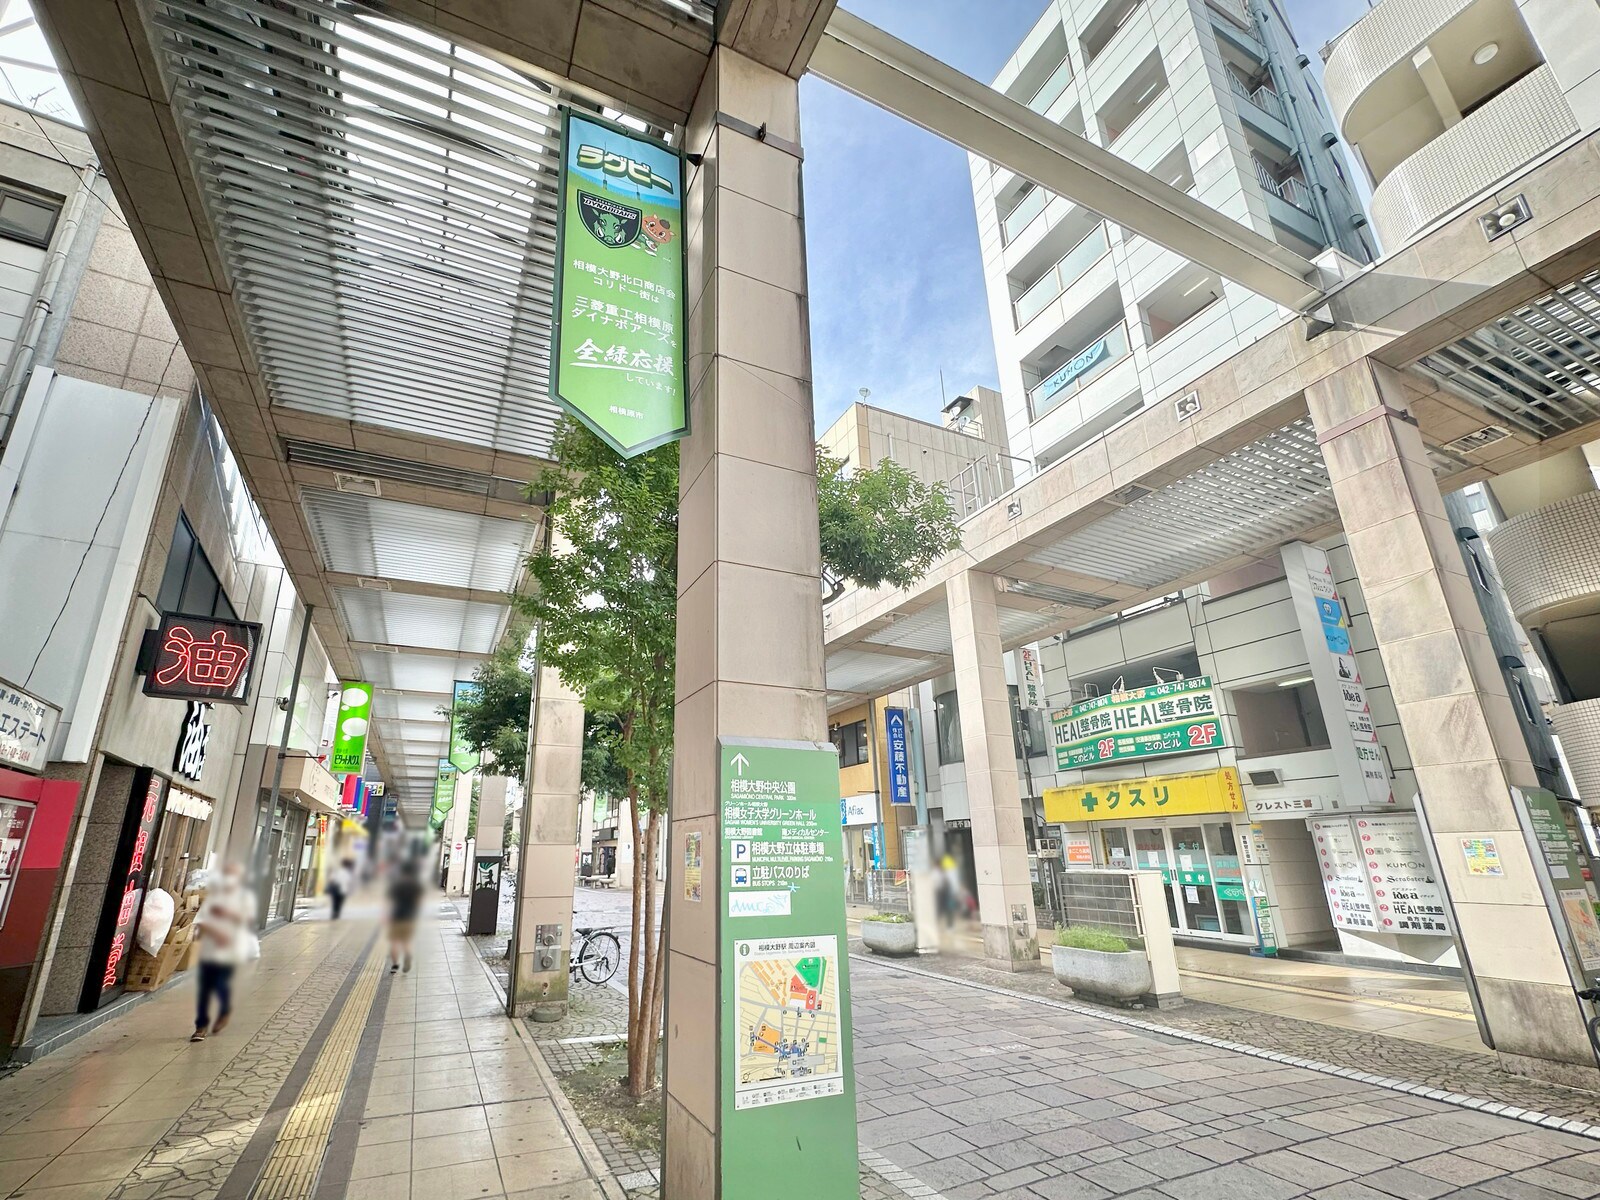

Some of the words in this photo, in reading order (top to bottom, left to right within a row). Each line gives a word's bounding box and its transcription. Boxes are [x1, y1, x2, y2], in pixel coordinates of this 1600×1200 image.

[577, 144, 674, 195] ラグビー
[573, 259, 675, 300] 相模大野北口商店会
[593, 276, 660, 303] コリドー街は
[574, 295, 674, 335] 三菱重工相模原
[573, 338, 675, 377] 全緑応援
[1053, 351, 1094, 387] KUMON
[608, 405, 645, 420] 相模原市
[157, 627, 248, 687] 油
[1156, 679, 1207, 695] 042-747-8874
[1188, 724, 1217, 746] 2F
[1098, 738, 1114, 758] 2F
[1145, 739, 1182, 751] このビル
[1073, 752, 1095, 764] このビル
[893, 740, 908, 797] 安藤不動産
[730, 779, 796, 795] 相模大野中央公園
[1225, 771, 1239, 810] 処方せん
[1106, 786, 1169, 811] クスリ
[725, 807, 817, 821] 相模女子大学グリーンホール
[848, 806, 864, 815] Aflac
[736, 843, 746, 859] P
[752, 842, 825, 857] 相模大野立体駐車場
[752, 865, 810, 880] 立駐バスのりば
[1386, 861, 1425, 870] KUMON
[1393, 891, 1419, 900] idea
[758, 943, 787, 952] 相模大野駅
[788, 941, 816, 950] 周辺案内図
